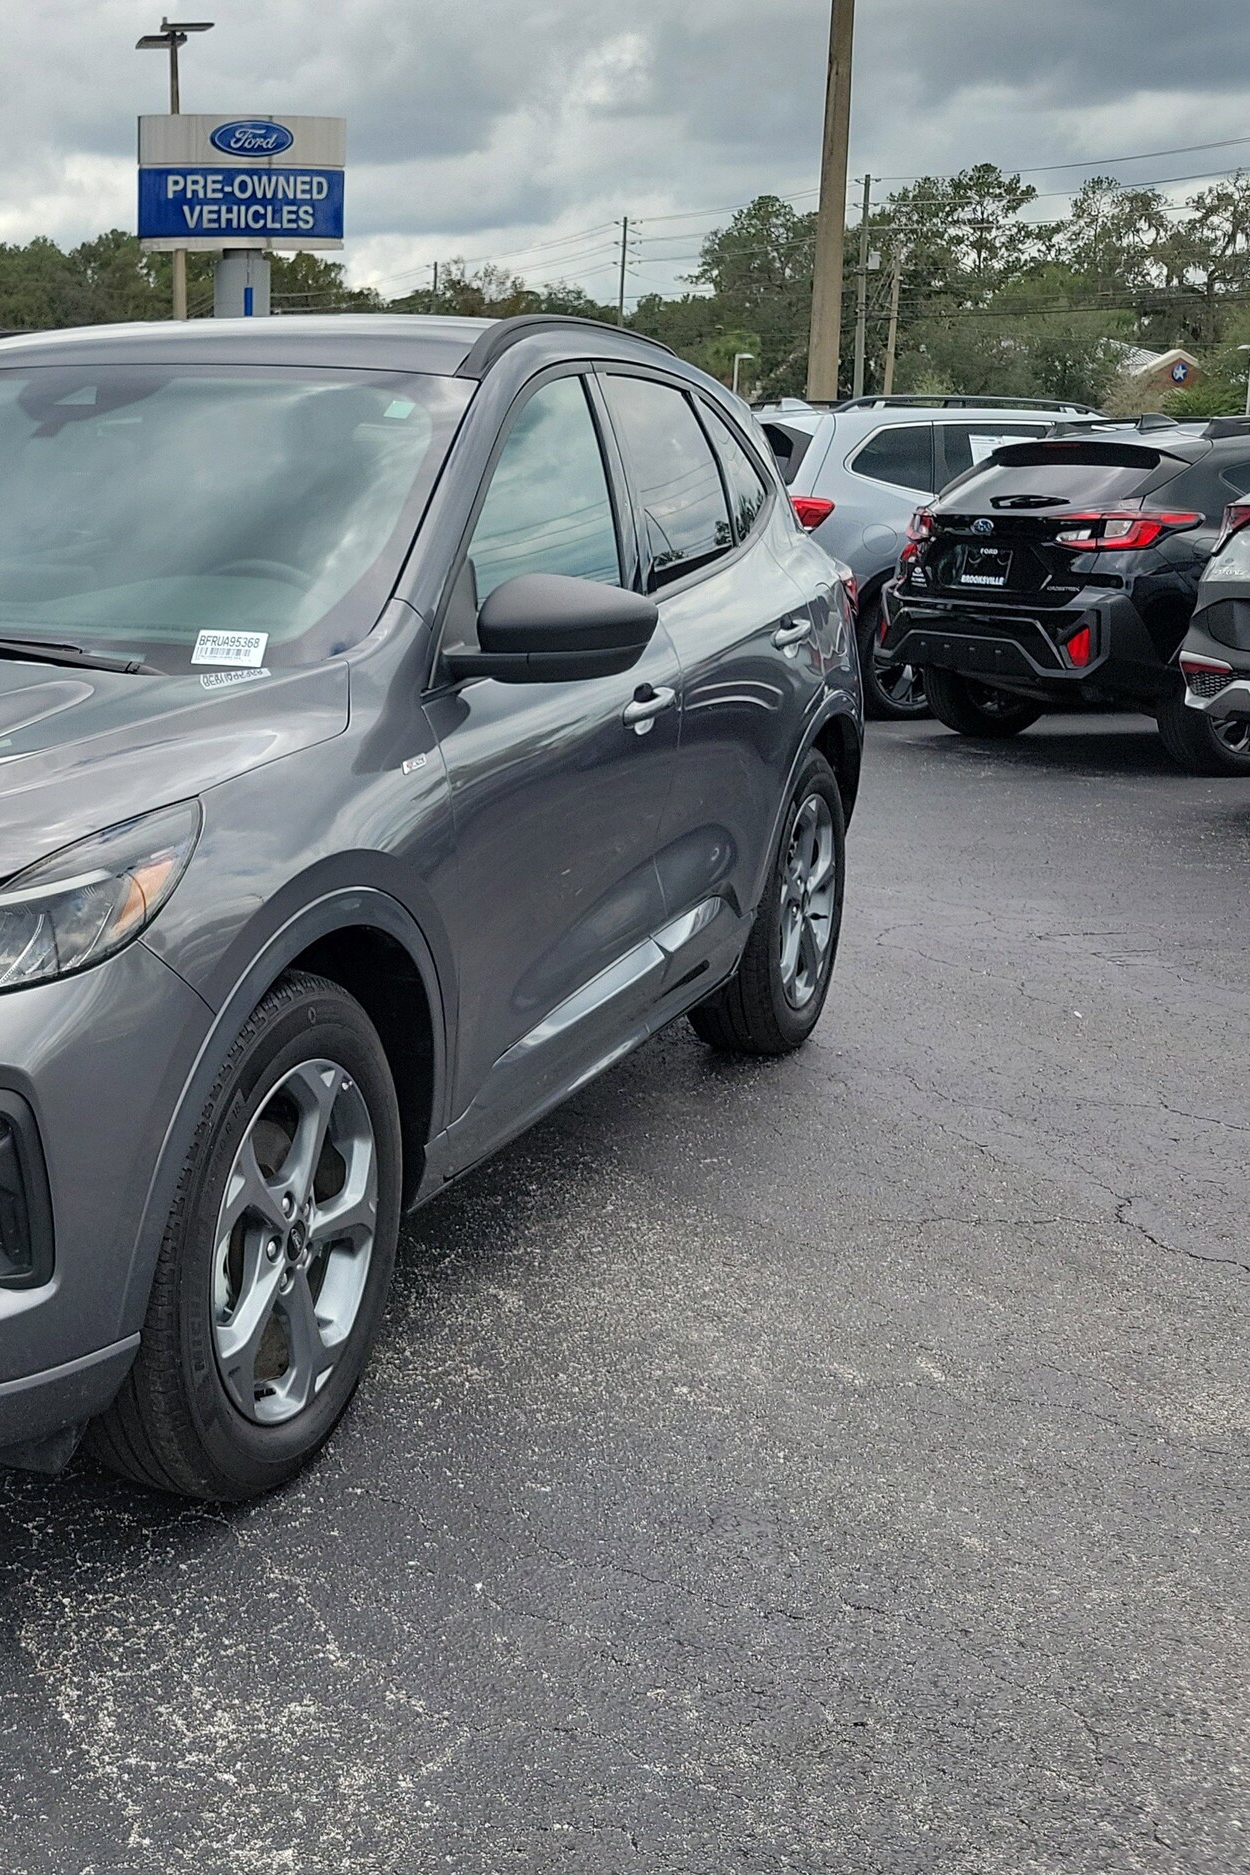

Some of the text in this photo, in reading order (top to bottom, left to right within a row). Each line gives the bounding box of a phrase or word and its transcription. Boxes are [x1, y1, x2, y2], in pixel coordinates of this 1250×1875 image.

[230, 128, 277, 149] Ford
[166, 174, 329, 200] PRE-OWNED
[182, 204, 315, 230] VEHICLES
[980, 547, 999, 555] FORD
[961, 574, 1005, 586] BROOKSVILLE
[198, 634, 261, 649] BFRUA95368
